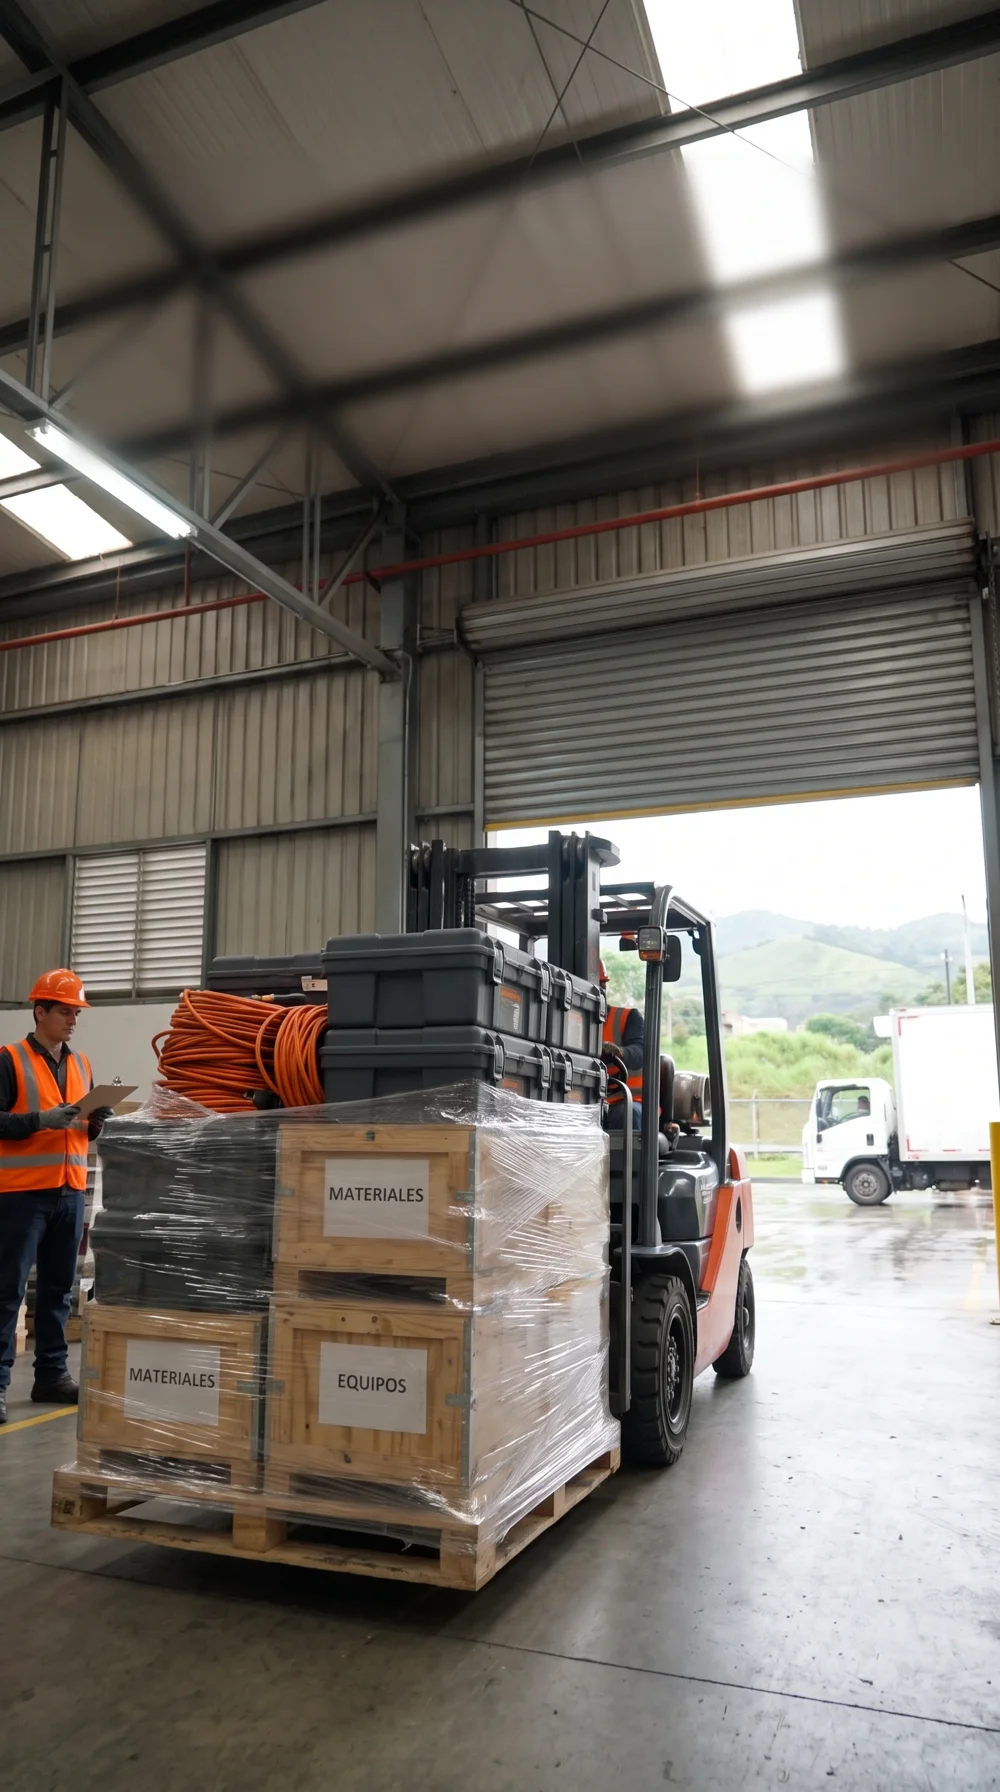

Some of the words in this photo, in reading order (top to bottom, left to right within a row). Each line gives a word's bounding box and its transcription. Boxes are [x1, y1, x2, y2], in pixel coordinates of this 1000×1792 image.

[329, 1187, 424, 1202] MATERIALES
[129, 1367, 215, 1389] MATERIALES
[338, 1373, 406, 1393] EQUIPOS
